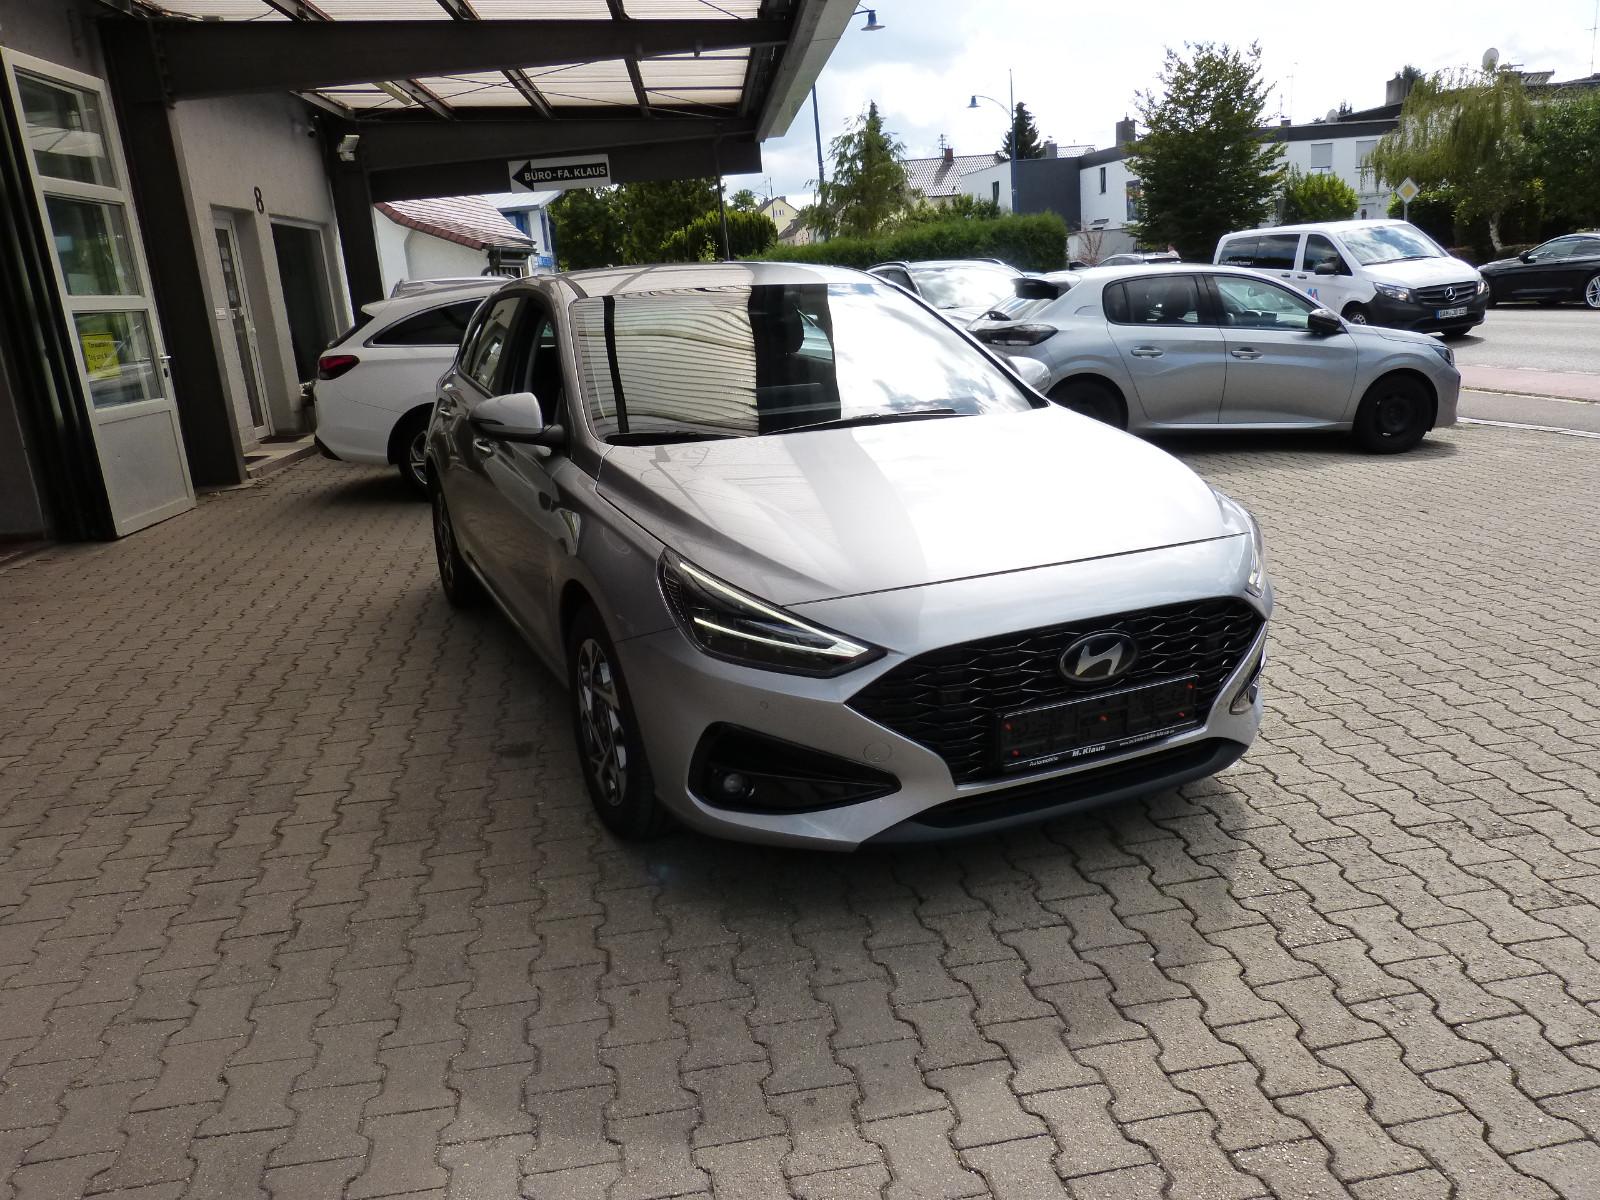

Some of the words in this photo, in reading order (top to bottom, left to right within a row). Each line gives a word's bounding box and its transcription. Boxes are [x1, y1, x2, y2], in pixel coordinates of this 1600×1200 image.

[574, 166, 606, 177] KLAUS
[253, 186, 265, 215] 8
[1082, 745, 1106, 755] Klaus
